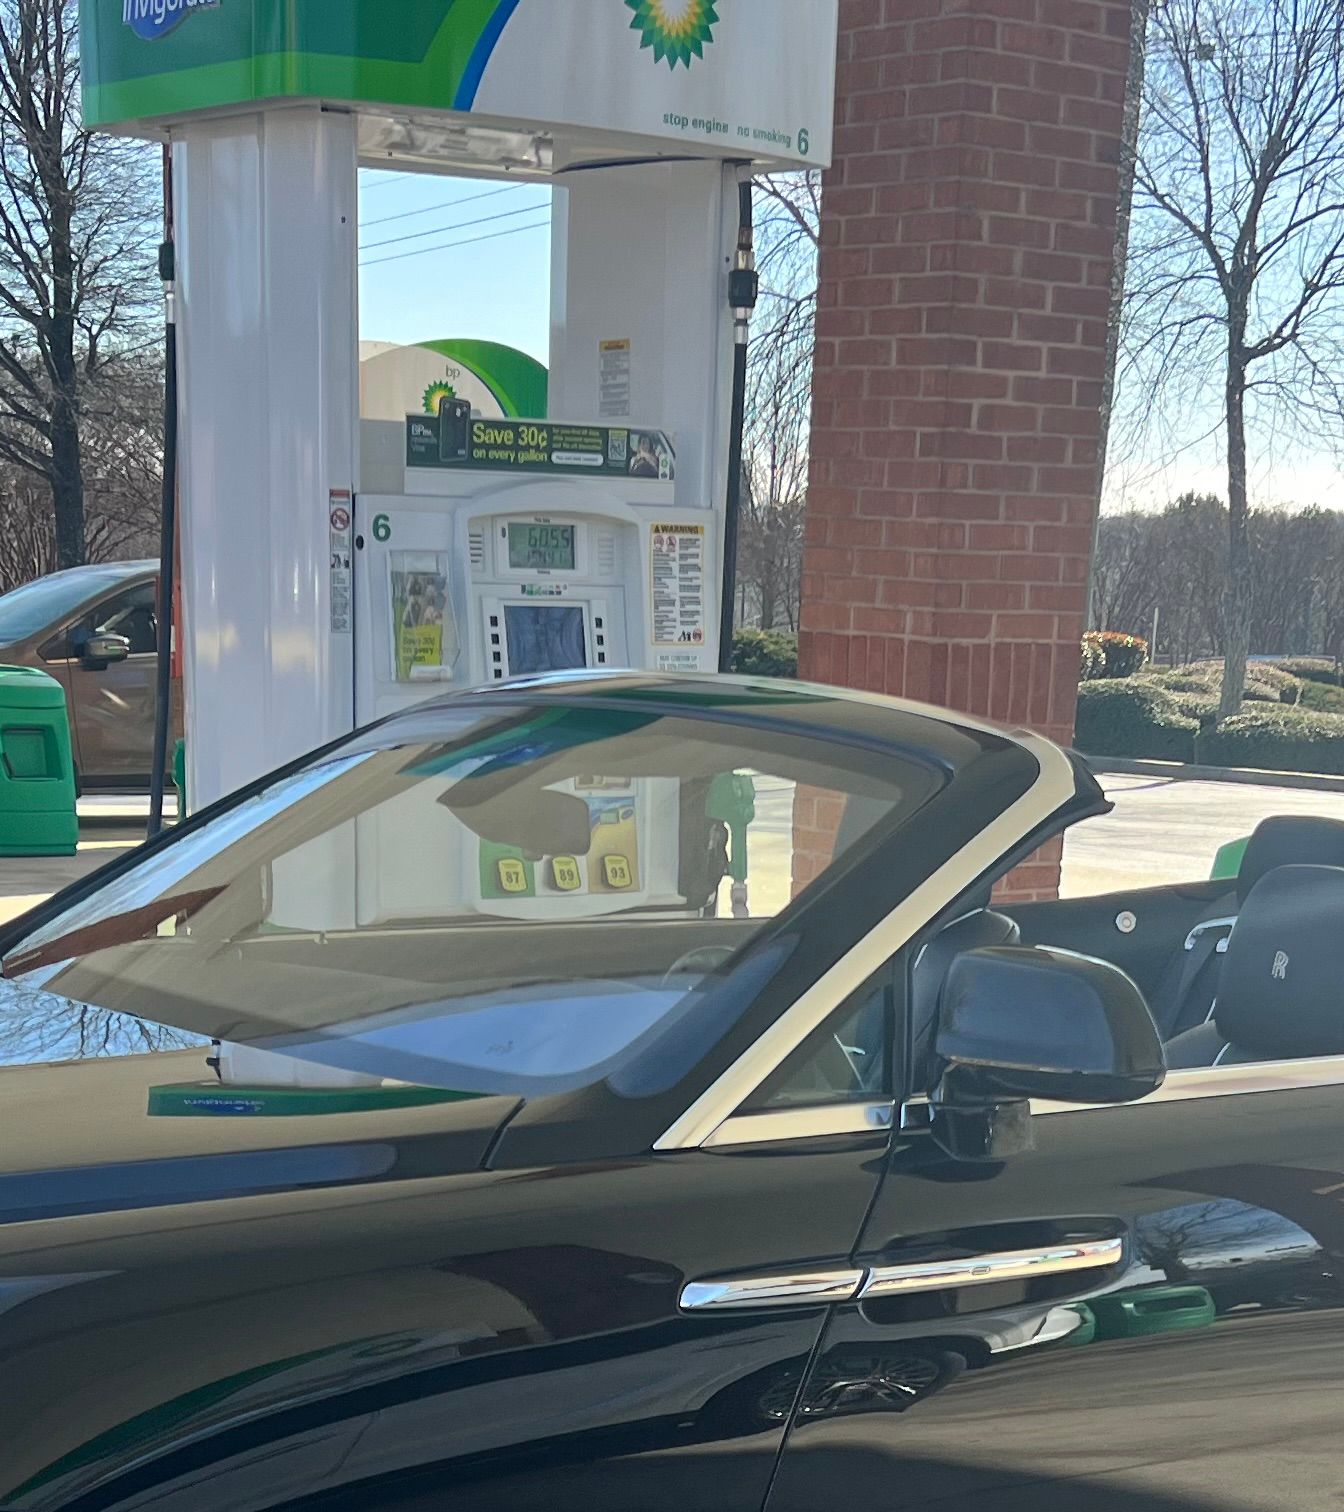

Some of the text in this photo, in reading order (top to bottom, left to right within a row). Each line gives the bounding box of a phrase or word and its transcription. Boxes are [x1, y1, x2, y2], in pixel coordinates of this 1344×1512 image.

[663, 112, 791, 148] stop engine no smoking
[797, 128, 809, 155] 6
[445, 365, 461, 379] bp
[473, 422, 514, 446] Save
[518, 425, 548, 450] 30¢
[473, 448, 548, 464] on every gallon
[372, 513, 391, 542] 6
[505, 870, 520, 884] 87
[559, 868, 575, 881] 89
[610, 866, 626, 879] 93
